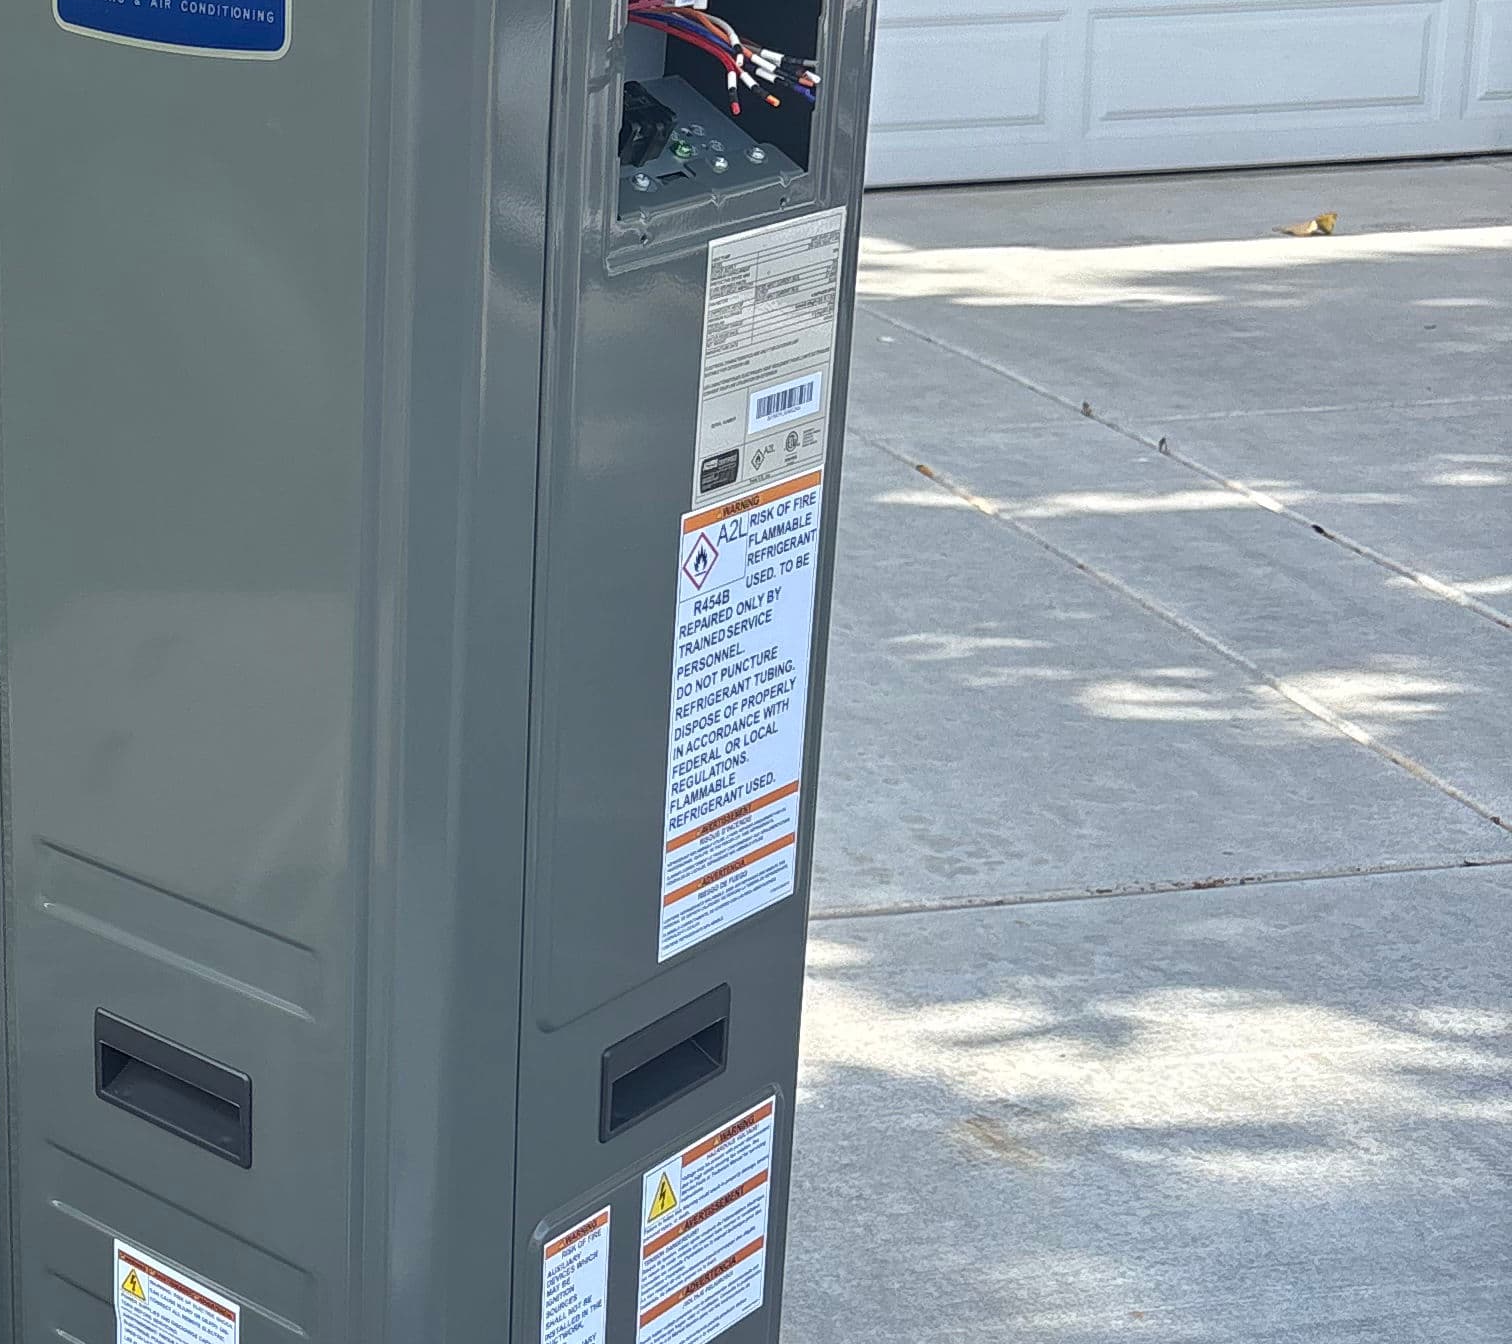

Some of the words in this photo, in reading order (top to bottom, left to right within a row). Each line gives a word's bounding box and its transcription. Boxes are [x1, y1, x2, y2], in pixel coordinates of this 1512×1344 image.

[180, 0, 275, 23] CONDITIONING
[722, 495, 759, 516] WARNING
[749, 506, 774, 527] RISK
[776, 500, 790, 517] OF
[793, 490, 816, 511] FIRE
[716, 515, 748, 547] A2L
[747, 528, 816, 566] REFRIGERANT
[748, 511, 811, 547] FLAMMABLE
[779, 558, 793, 575] TO
[796, 552, 810, 569] BE
[678, 605, 732, 640] REPAIRED
[736, 592, 764, 616] ONLY
[766, 586, 781, 604] BY
[693, 588, 730, 616] R454B
[678, 627, 725, 659] TRAINED
[726, 608, 772, 639] SERVICE
[675, 676, 751, 721] REFRIGERANT
[753, 657, 795, 687] TUBING.
[676, 681, 692, 700] DO
[695, 670, 718, 692] NOT
[720, 645, 778, 682] PUNCTURE
[673, 743, 683, 761] IN
[685, 709, 760, 755] ACCORDANCE
[763, 697, 789, 721] WITH
[674, 708, 721, 742] DISPOSE
[723, 701, 738, 719] OF
[740, 676, 796, 712] PROPERLY
[671, 745, 721, 779] FEDERAL
[724, 735, 740, 755] OR
[743, 719, 778, 747] LOCAL
[669, 771, 735, 814] FLAMMABLE
[671, 748, 749, 796] REGULATIONS.
[668, 783, 745, 831] REFRIGERANT
[745, 768, 776, 795] USED.
[720, 1113, 754, 1143] WARNING
[685, 1184, 743, 1230] AVERTISSEMENT
[686, 1254, 736, 1296] ADVERTENCIA
